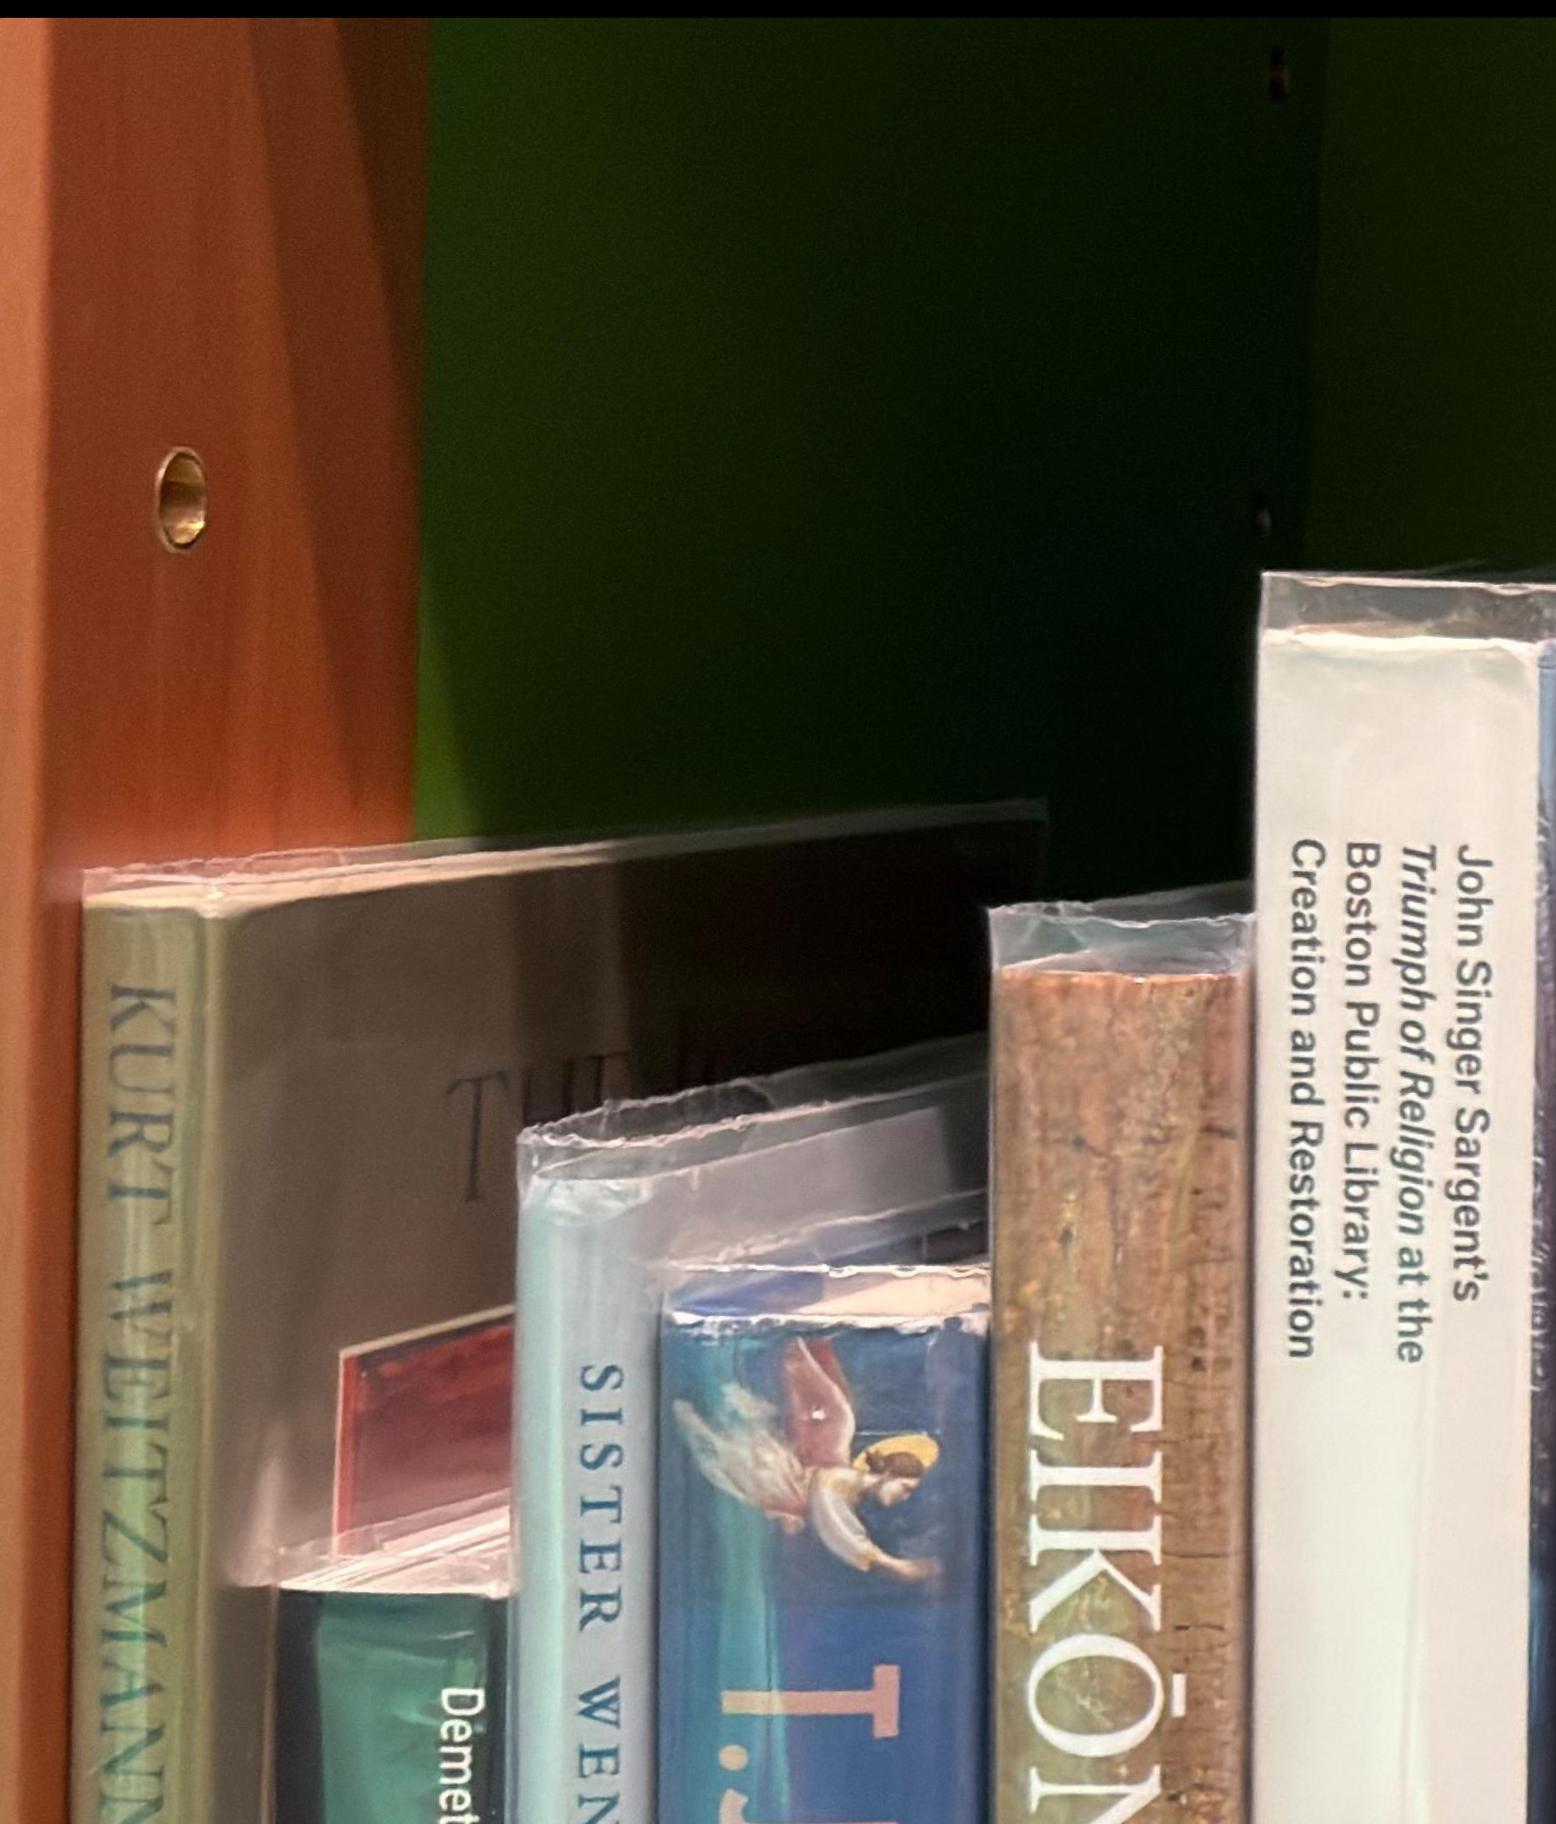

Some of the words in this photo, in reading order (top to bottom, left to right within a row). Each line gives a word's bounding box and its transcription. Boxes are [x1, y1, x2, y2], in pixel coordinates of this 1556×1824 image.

[1291, 839, 1326, 1016] Creation
[1348, 842, 1380, 987] Boston
[1391, 845, 1437, 1008] Triumph
[1456, 844, 1492, 946] John
[1291, 1031, 1324, 1102] and
[1345, 998, 1380, 1128] Public
[1402, 1011, 1434, 1064] of
[1446, 957, 1491, 1094] Singer
[107, 984, 175, 1228] KURT
[1390, 1070, 1435, 1232] Religion
[1285, 1118, 1324, 1359] Restoration
[1335, 1138, 1379, 1302] Library:
[1398, 1242, 1431, 1288] at
[1444, 1110, 1488, 1302] Sargent's
[1397, 1299, 1436, 1364] the
[578, 1365, 625, 1632] SISTER
